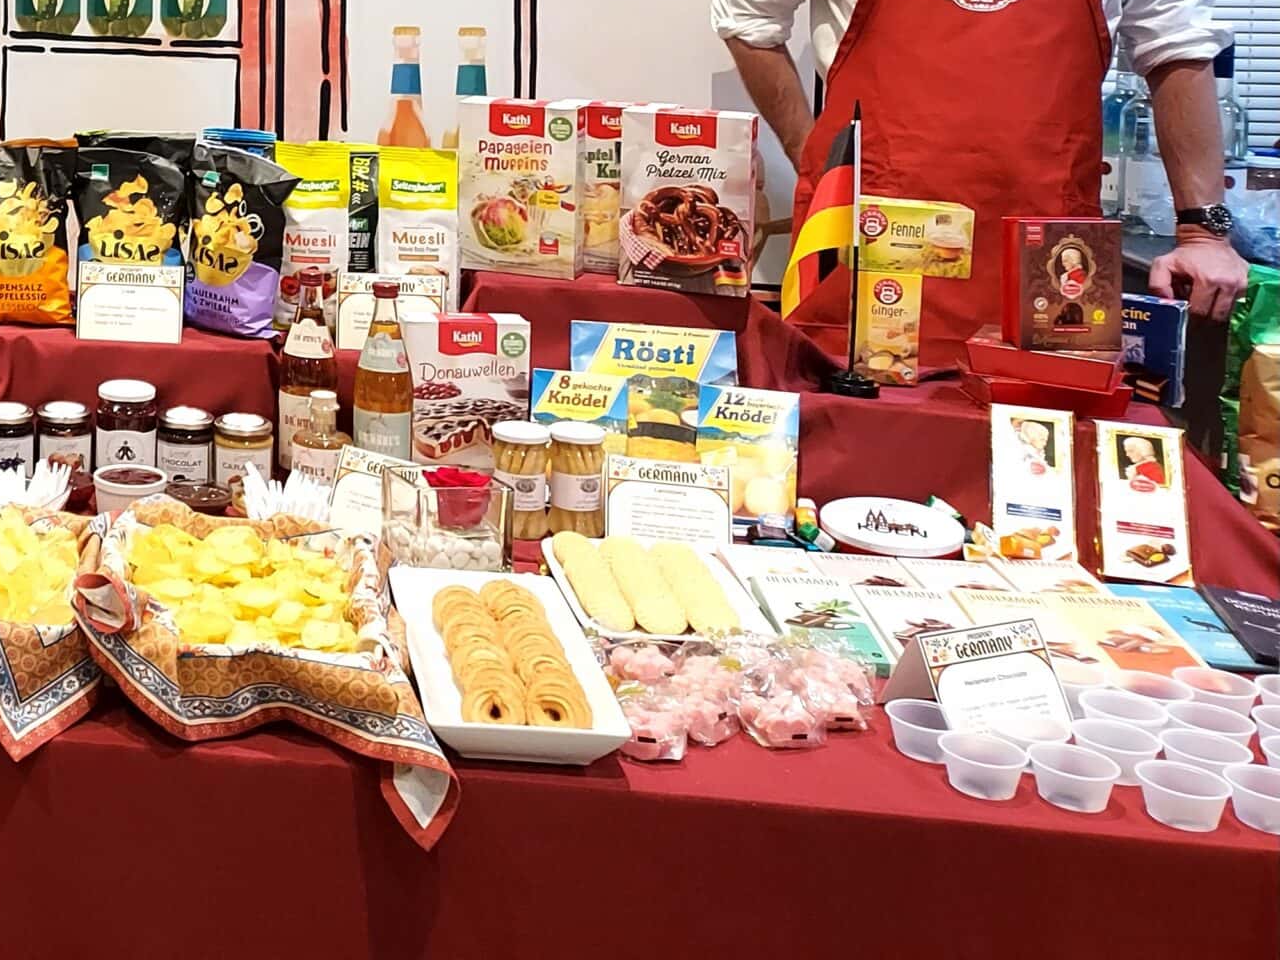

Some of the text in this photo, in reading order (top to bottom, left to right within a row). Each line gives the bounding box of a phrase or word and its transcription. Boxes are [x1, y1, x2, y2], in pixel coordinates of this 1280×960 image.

[502, 113, 531, 126] Kathi
[601, 115, 622, 126] Kat
[670, 122, 701, 135] Kathi
[478, 139, 553, 156] Papageien
[656, 150, 712, 167] German
[645, 164, 727, 182] Pretzel Mix
[392, 231, 445, 246] Muesli
[890, 221, 926, 239] Fennel
[285, 232, 337, 247] Muesli
[106, 271, 156, 284] GERMANY
[452, 330, 482, 343] Kathi
[612, 337, 696, 366] Rösti
[418, 359, 515, 382] Donauwellen
[559, 374, 571, 389] 8
[547, 389, 608, 409] Knödel
[723, 391, 746, 406] 12
[715, 406, 778, 425] Knödel
[638, 467, 698, 484] GERMANY
[954, 635, 1014, 659] GERMANY
